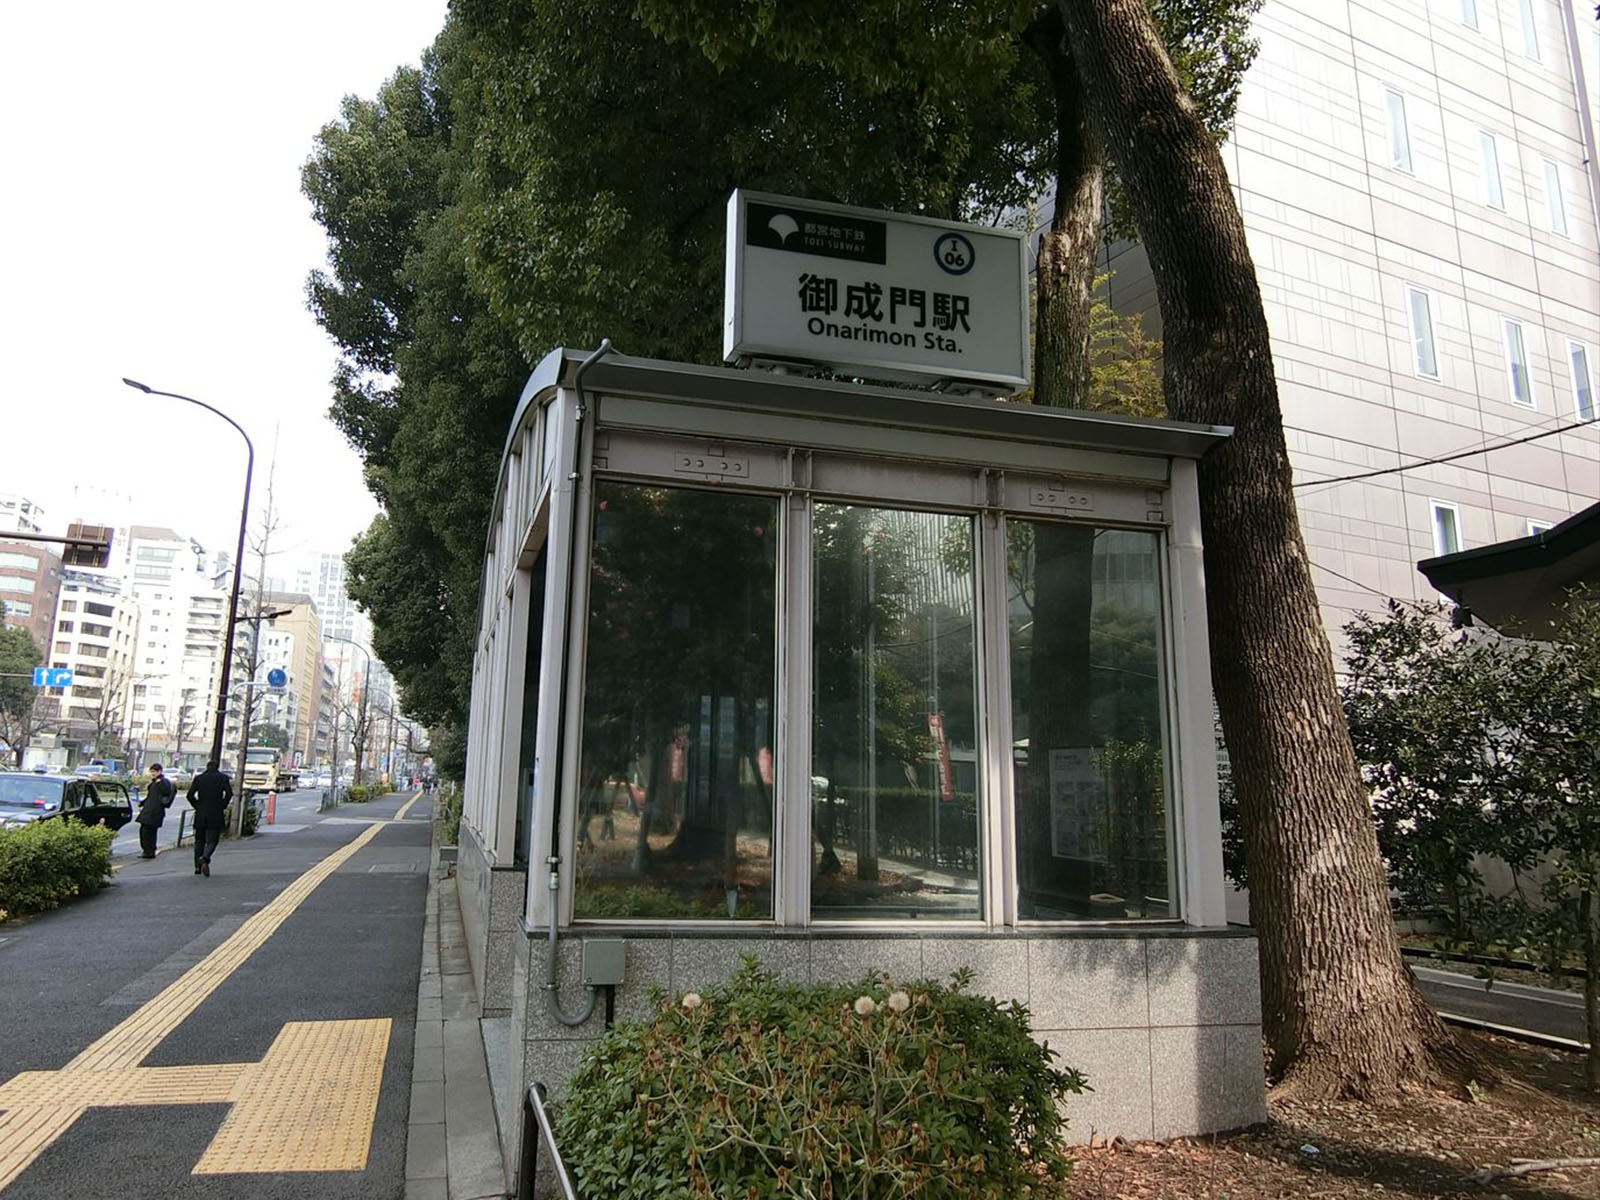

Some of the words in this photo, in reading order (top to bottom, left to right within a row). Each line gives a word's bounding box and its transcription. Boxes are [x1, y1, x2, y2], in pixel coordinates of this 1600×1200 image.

[804, 223, 865, 242] 都営地下鉄
[804, 237, 825, 248] TOEI
[828, 240, 865, 253] SUBWAY
[951, 239, 958, 251] I
[944, 252, 965, 267] 06
[798, 273, 971, 333] 御成門駅
[808, 317, 916, 347] Onarimon
[924, 332, 963, 353] Sta.
